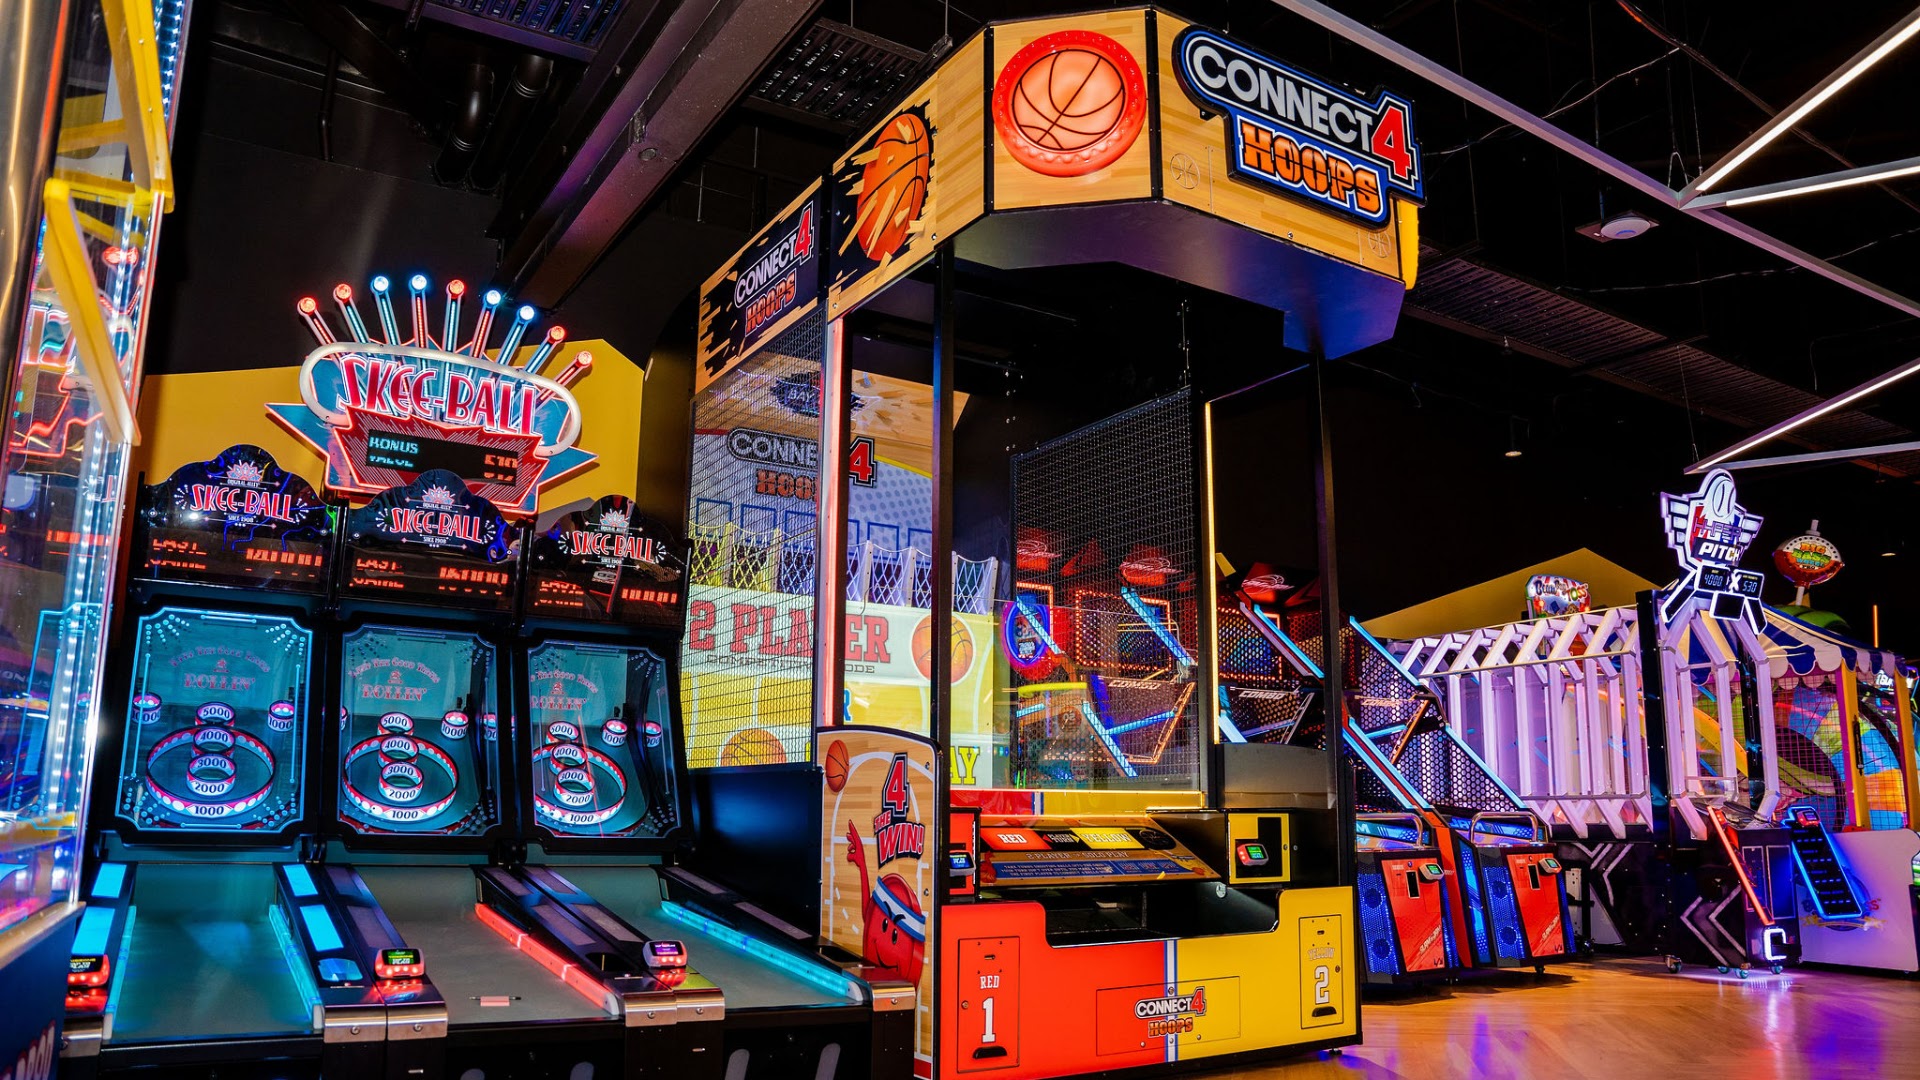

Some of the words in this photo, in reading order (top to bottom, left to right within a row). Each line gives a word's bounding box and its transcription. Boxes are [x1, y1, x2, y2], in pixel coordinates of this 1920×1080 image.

[1241, 121, 1382, 214] HOOPS
[745, 271, 796, 334] HOOPS
[336, 355, 538, 436] SKEE-BALL
[190, 484, 296, 524] SKEE-BALL
[389, 507, 484, 545] SKEE-BALL
[570, 530, 657, 565] SKEE-BALL
[1698, 541, 1741, 562] PITCH
[1800, 542, 1827, 554] BIG
[1791, 548, 1831, 564] BASS
[730, 603, 891, 664] PLAER
[706, 653, 813, 670] COMPETITIV
[202, 706, 231, 719] 5000
[382, 714, 408, 728] 5000
[200, 730, 229, 742] 4000
[384, 738, 411, 752] 4000
[554, 747, 579, 759] 4000
[196, 757, 227, 769] 3000
[386, 764, 414, 777] 3000
[559, 770, 585, 782] 3000
[194, 780, 225, 794] 2000
[886, 759, 906, 812] 4
[388, 788, 416, 800] 2000
[565, 793, 591, 804] 2000
[193, 804, 225, 816] 1000
[391, 809, 419, 820] 1000
[569, 813, 595, 824] 1000
[874, 809, 892, 834] THE
[878, 822, 925, 864] WIN!
[997, 833, 1028, 844] RED
[1080, 833, 1133, 842] YELLOW
[980, 975, 1000, 989] RED
[1314, 964, 1330, 1005] 2
[981, 997, 996, 1044] 1
[1149, 1018, 1193, 1037] HOOPS
